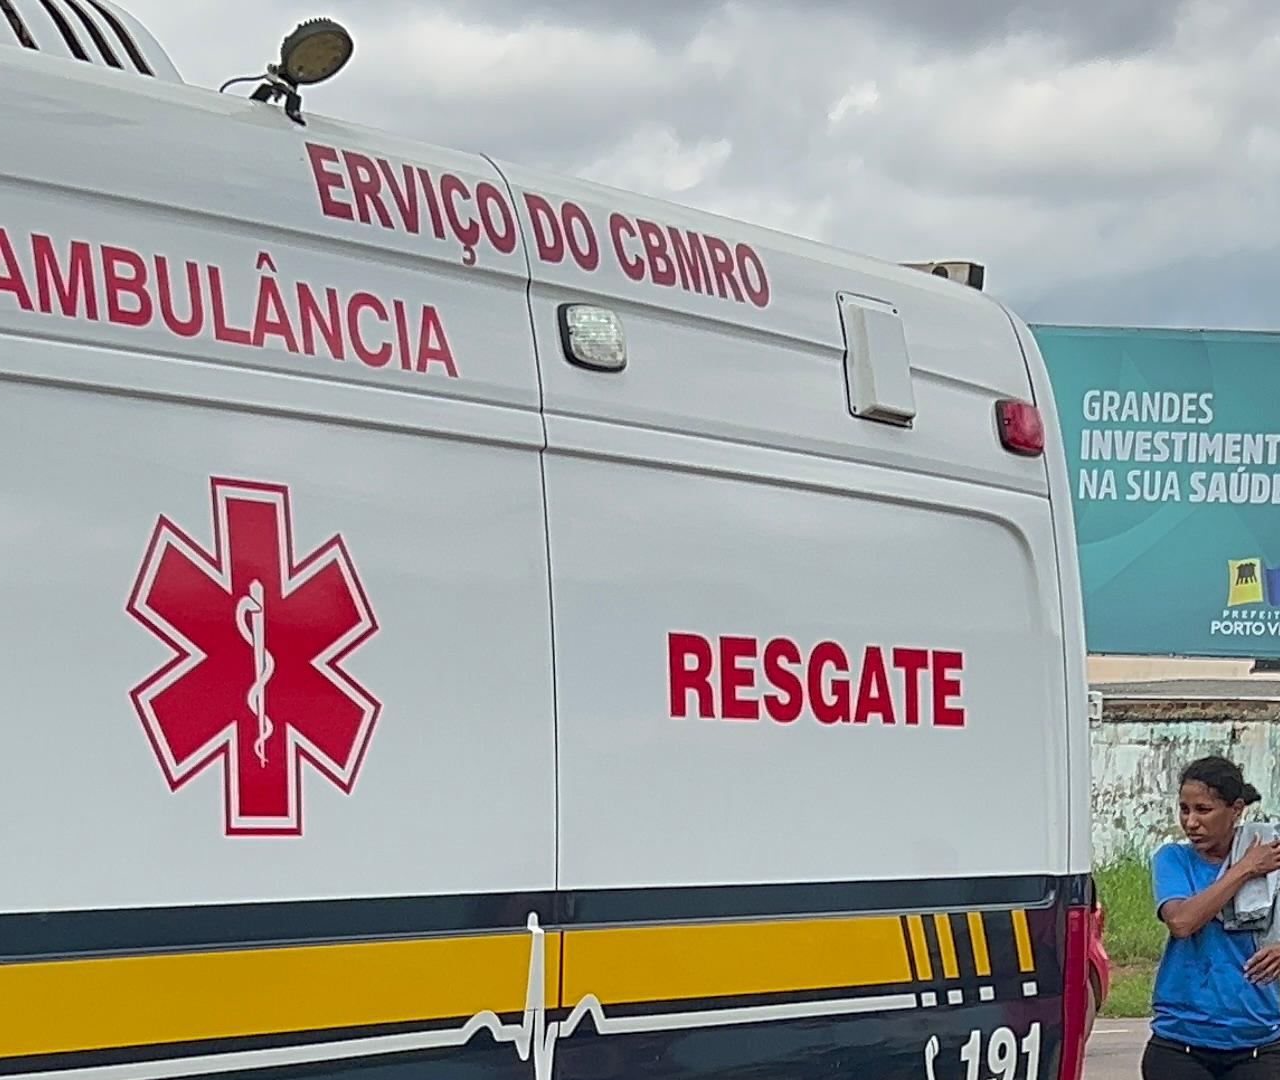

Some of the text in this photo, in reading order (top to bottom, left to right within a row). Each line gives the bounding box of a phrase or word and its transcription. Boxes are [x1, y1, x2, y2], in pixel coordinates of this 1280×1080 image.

[304, 141, 771, 308] ERVIÇO DO CBMRO
[1082, 390, 1214, 424] GRANDES
[1078, 468, 1118, 500] NA
[1125, 469, 1182, 502] SUA
[1210, 620, 1266, 637] PORTO
[666, 630, 966, 728] RESGATE
